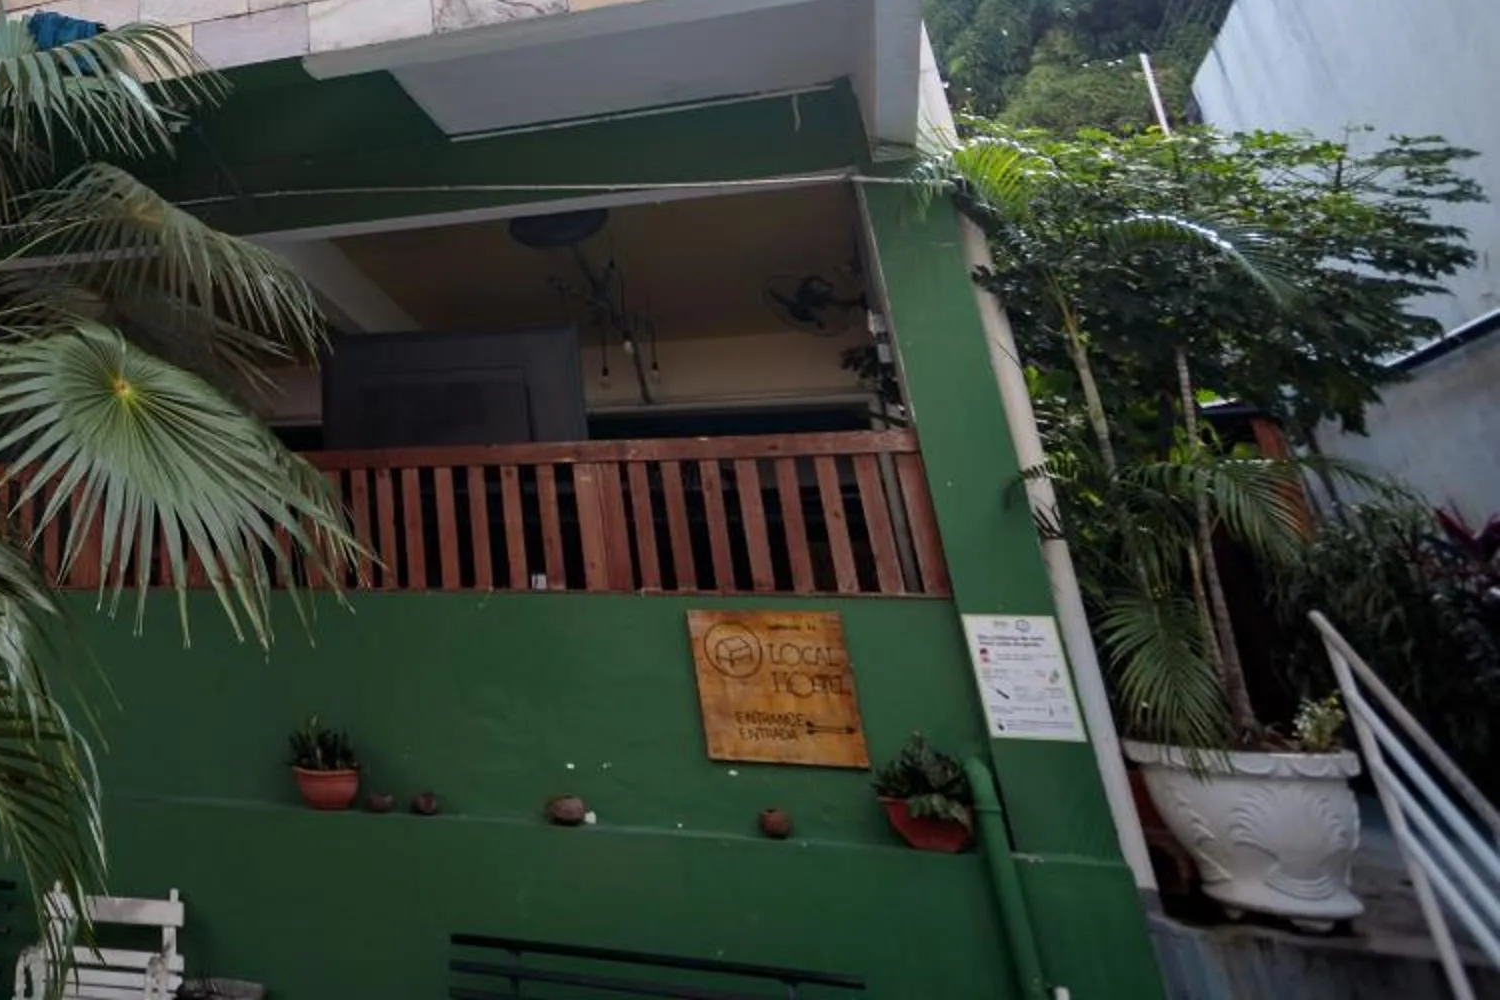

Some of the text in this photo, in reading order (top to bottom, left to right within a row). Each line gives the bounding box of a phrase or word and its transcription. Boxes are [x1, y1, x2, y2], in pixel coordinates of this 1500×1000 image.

[767, 643, 840, 667] LOCAL
[734, 711, 804, 727] ENTRANCE
[739, 727, 799, 740] ENTRADA
